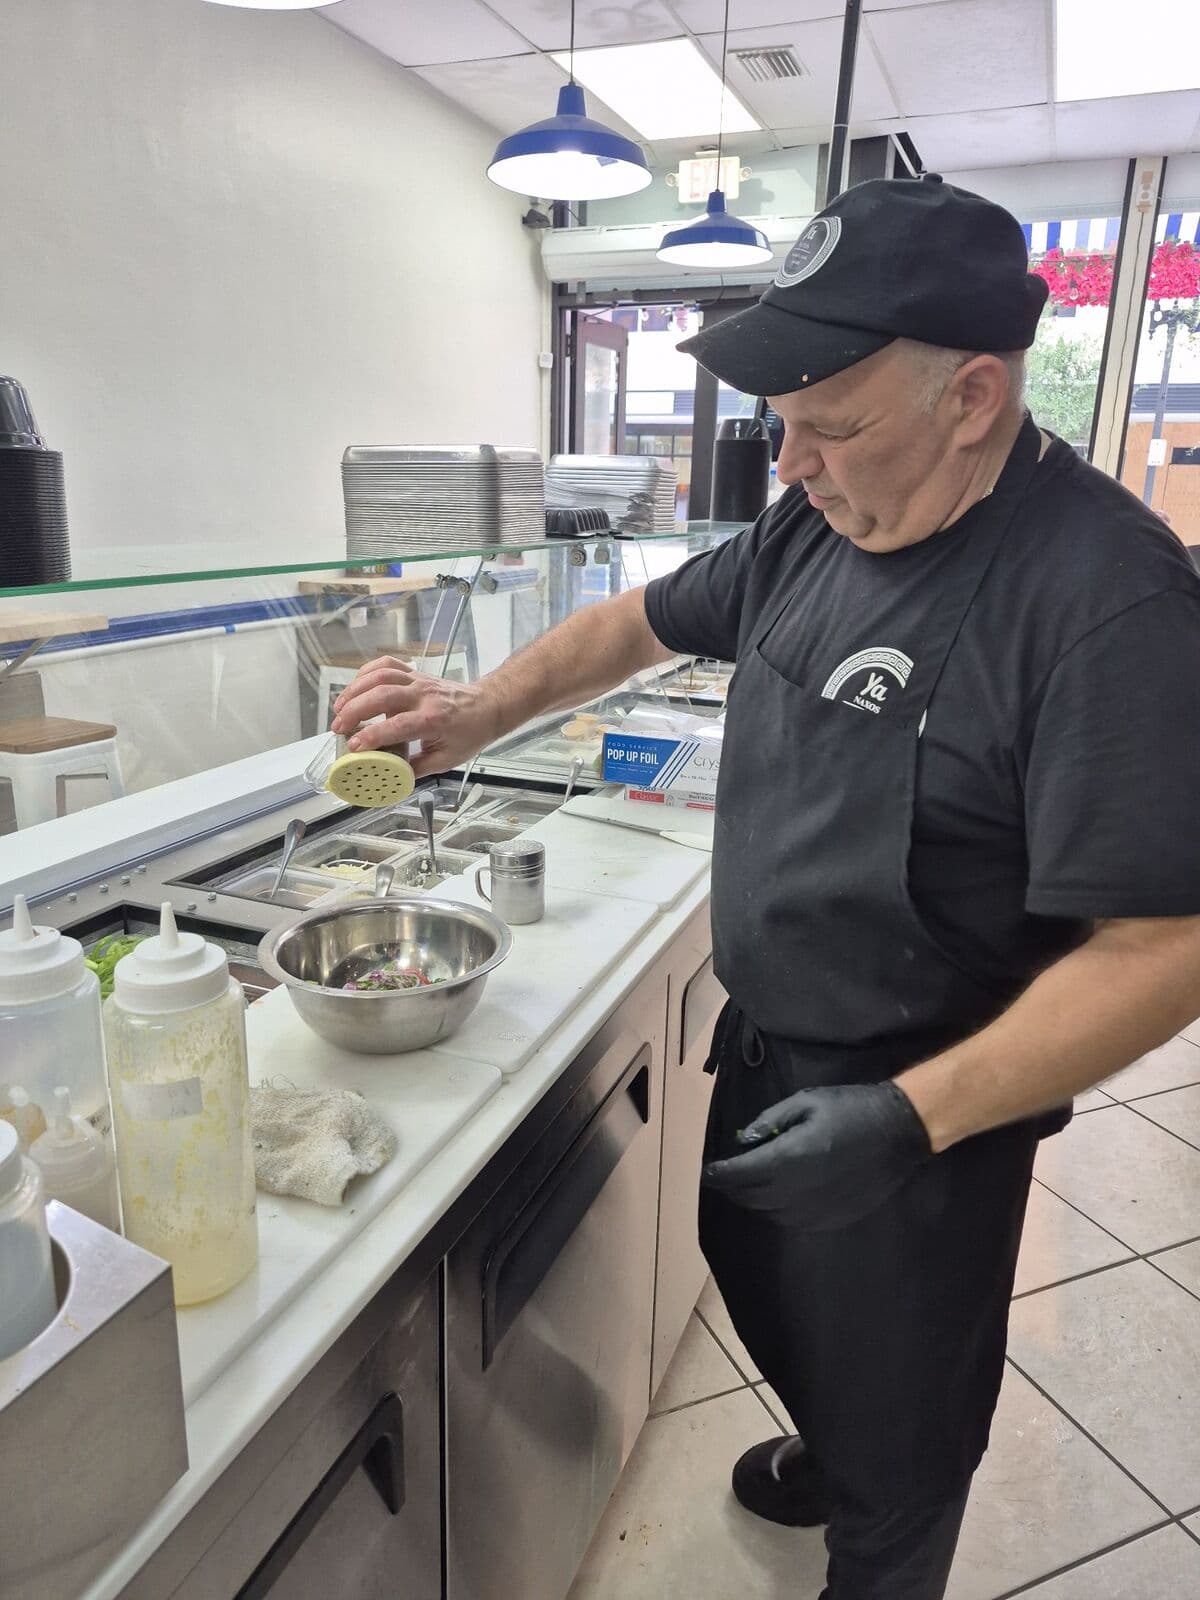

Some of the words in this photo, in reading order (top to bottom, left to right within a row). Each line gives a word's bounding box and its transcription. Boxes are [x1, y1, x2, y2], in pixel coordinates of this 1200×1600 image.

[860, 672, 888, 701] Ya
[853, 695, 881, 714] NAXOS
[607, 748, 625, 761] POP
[626, 750, 639, 762] UP
[640, 752, 659, 765] FOIL
